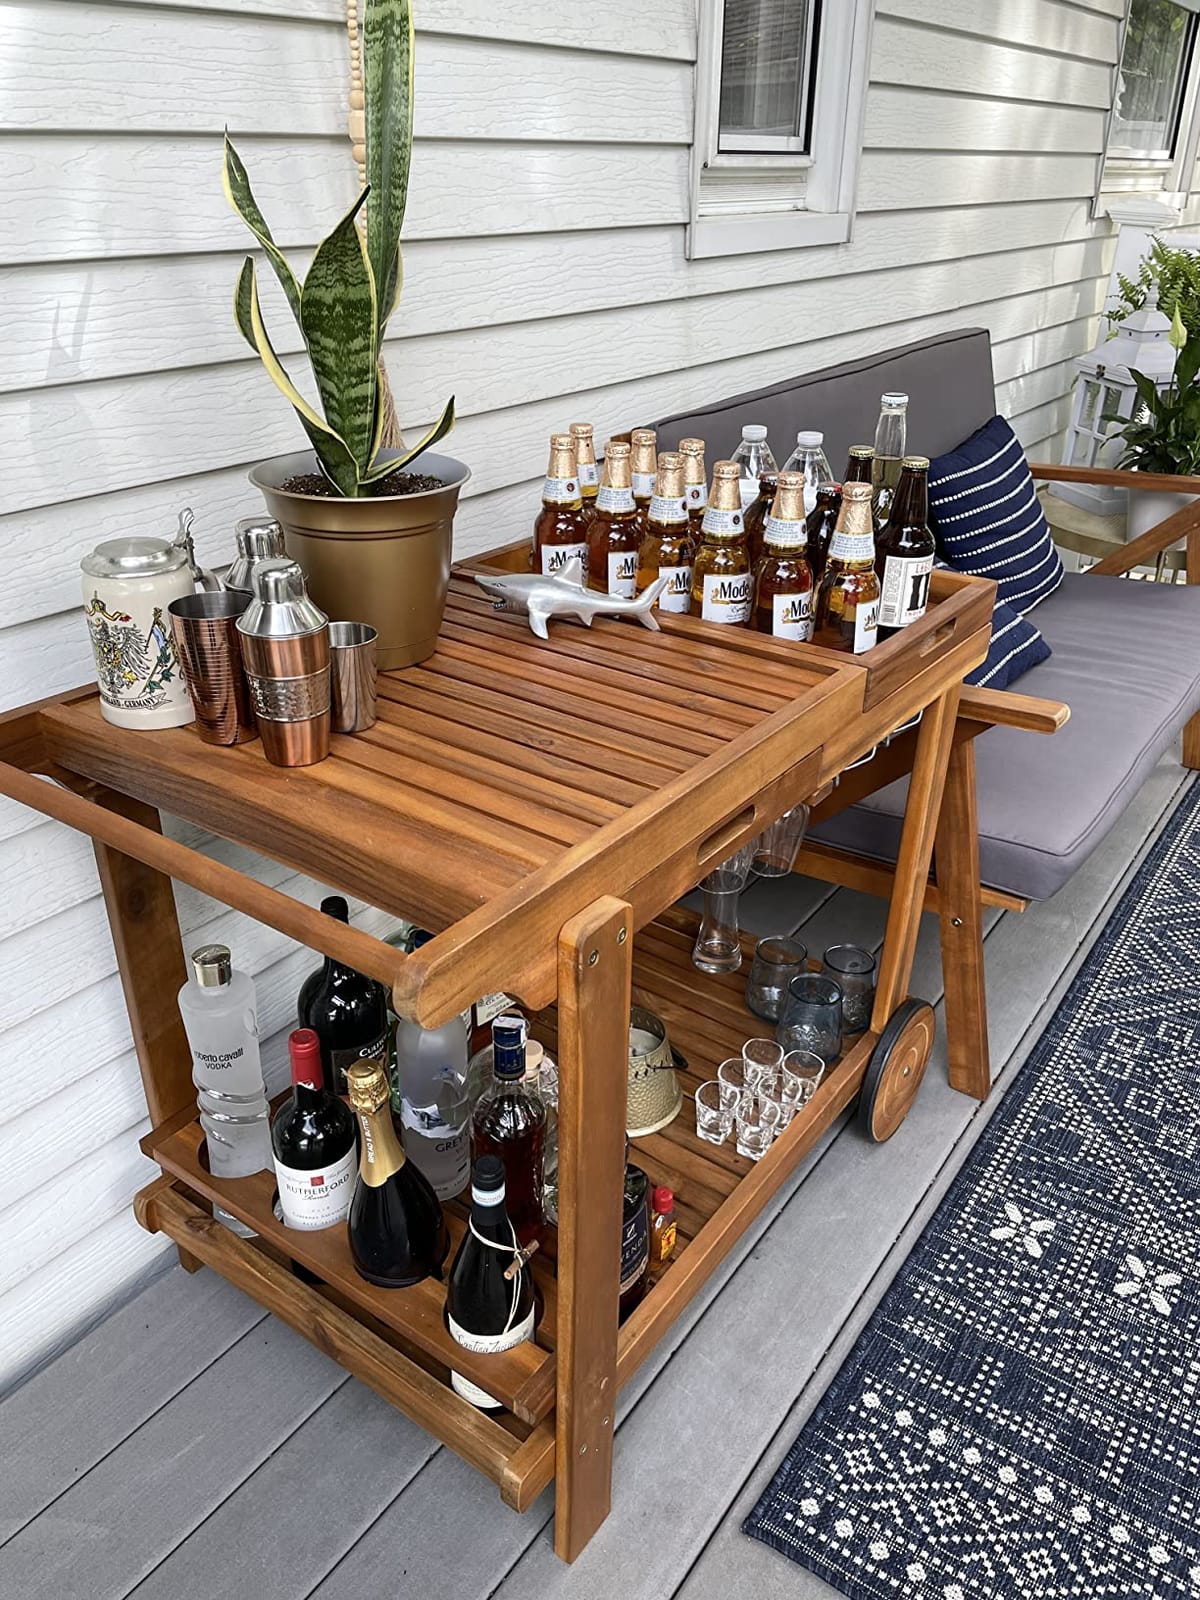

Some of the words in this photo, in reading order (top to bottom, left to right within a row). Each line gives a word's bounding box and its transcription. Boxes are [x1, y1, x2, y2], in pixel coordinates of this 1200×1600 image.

[124, 697, 156, 708] GERMANY
[219, 1047, 244, 1062] cavalli
[205, 1062, 232, 1070] VODKA
[361, 1115, 371, 1137] BUTTER
[367, 1142, 375, 1164] BREAD
[435, 1136, 463, 1153] GREY
[286, 1173, 350, 1195] RUTHERFORD
